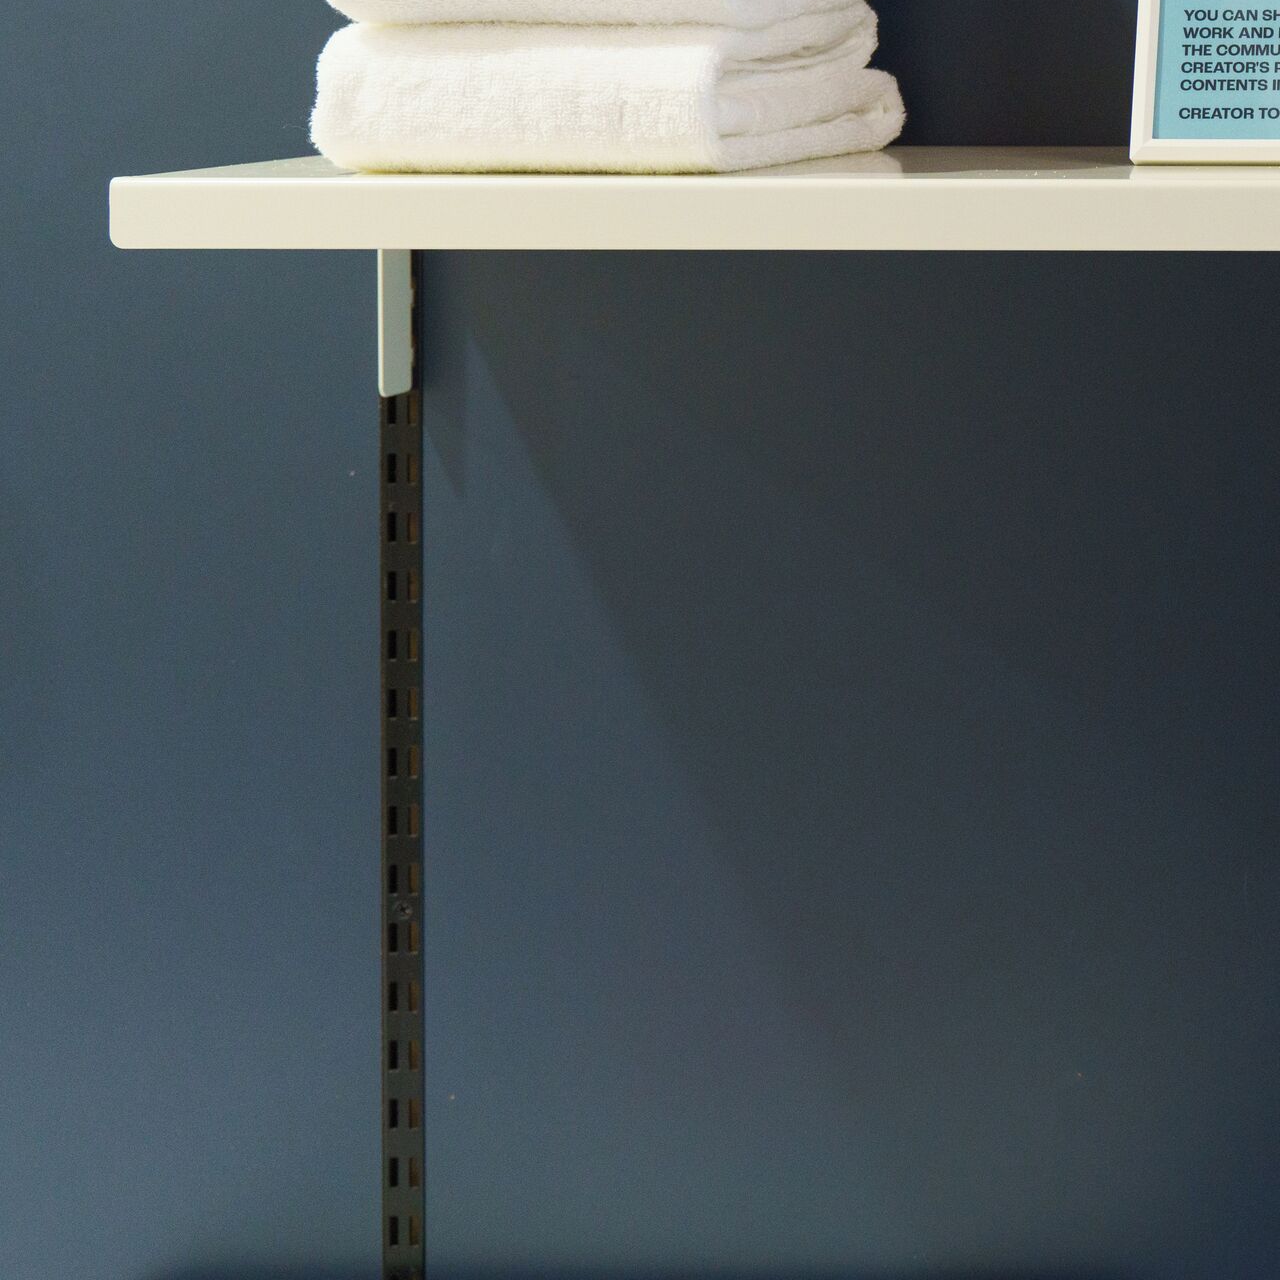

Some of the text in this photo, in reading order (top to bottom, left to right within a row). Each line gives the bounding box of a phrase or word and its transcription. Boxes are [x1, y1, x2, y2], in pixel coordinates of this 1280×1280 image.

[1184, 10, 1218, 21] YOU
[1223, 10, 1257, 21] CAN
[1183, 27, 1233, 38] WORK
[1239, 27, 1274, 38] AND
[1182, 45, 1212, 56] THE
[1181, 62, 1269, 73] CREATOR'S
[1181, 79, 1267, 90] CONTENTS
[1179, 108, 1254, 119] CREATOR
